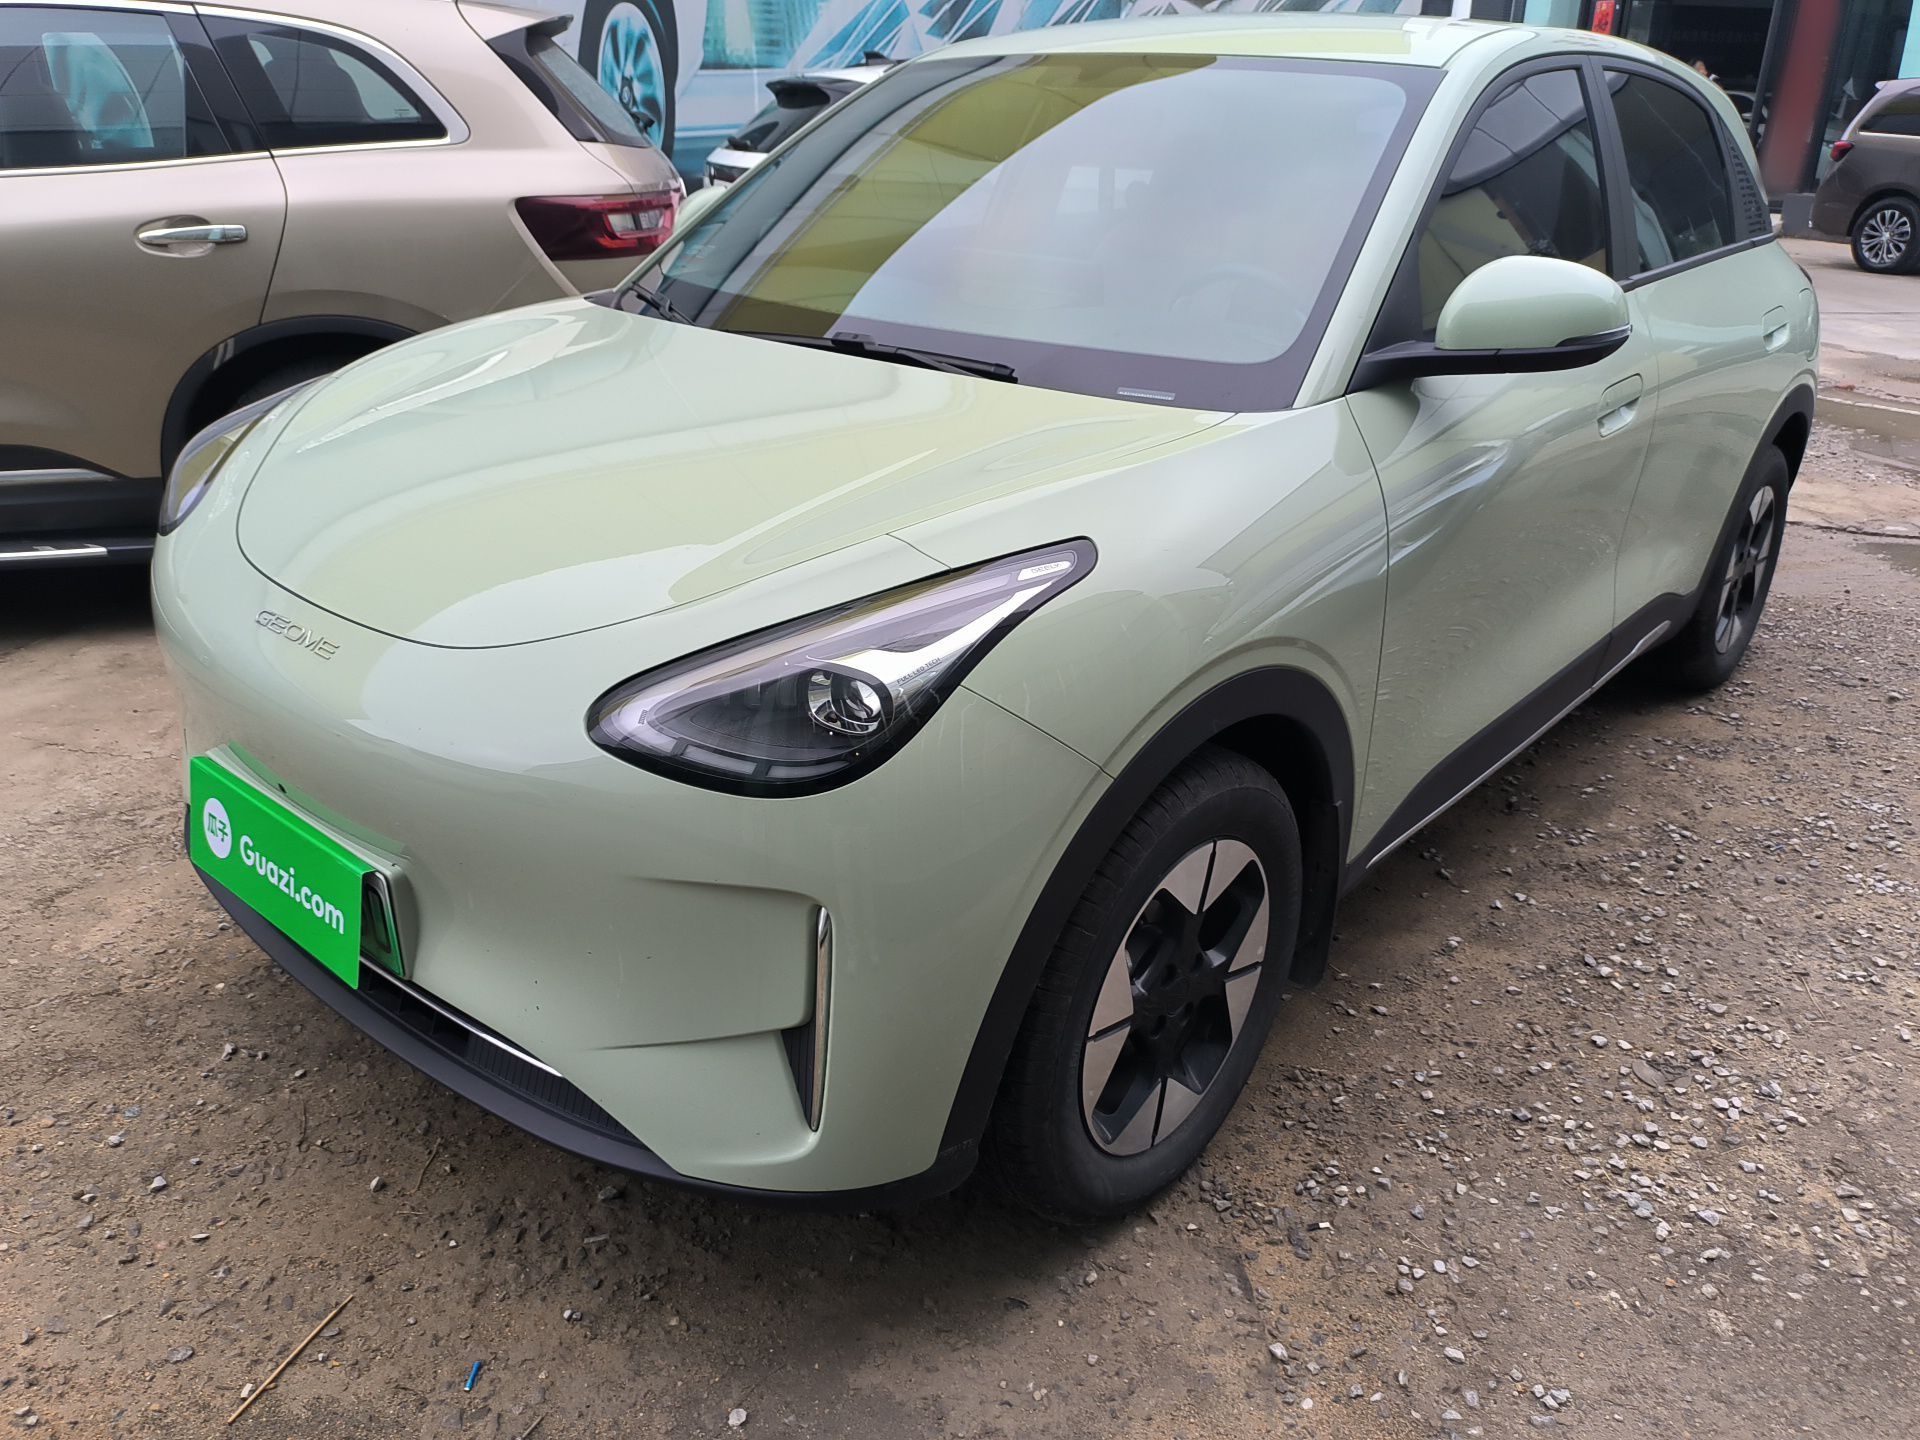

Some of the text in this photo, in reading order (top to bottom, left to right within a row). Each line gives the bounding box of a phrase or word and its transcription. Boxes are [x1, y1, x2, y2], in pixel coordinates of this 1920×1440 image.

[255, 610, 341, 660] GEOME
[207, 811, 229, 842] 瓜子
[239, 834, 345, 935] Guazi.com
